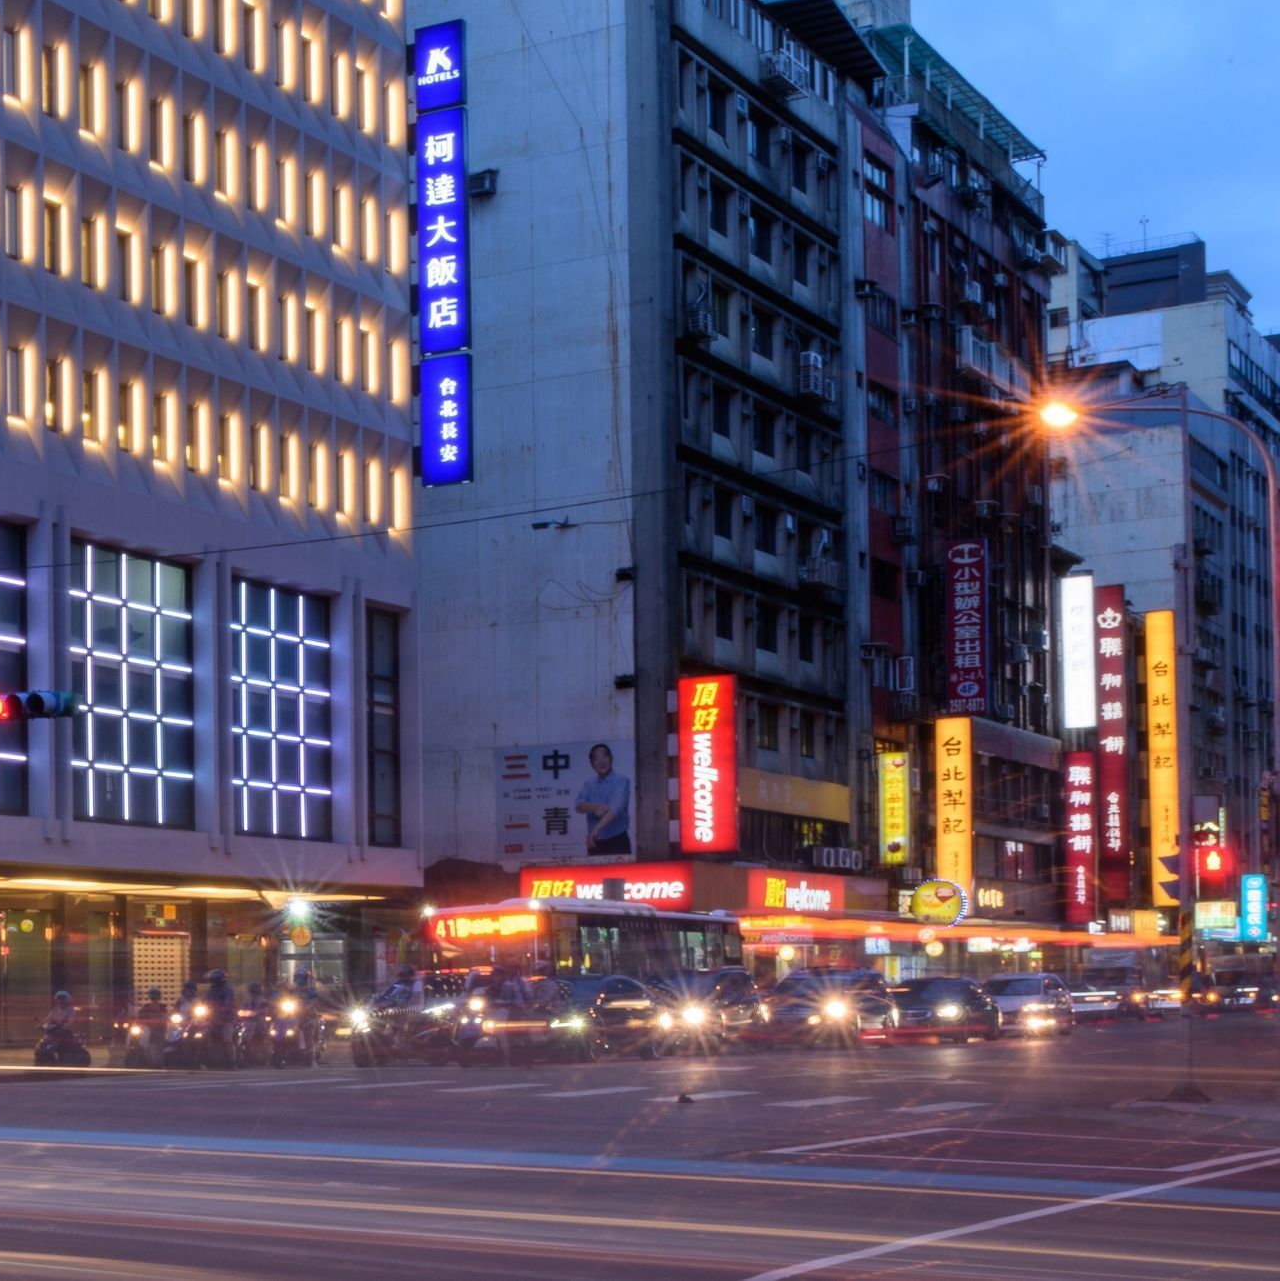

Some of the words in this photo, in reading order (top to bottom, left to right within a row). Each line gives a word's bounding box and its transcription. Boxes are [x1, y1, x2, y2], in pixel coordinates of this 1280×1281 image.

[418, 69, 460, 86] HOTELS
[424, 131, 459, 329] 柯達大飯店
[439, 376, 459, 463] 台北長安
[952, 567, 982, 669] 小型辦公室出租
[692, 682, 719, 732] 頂好
[960, 683, 976, 694] 4F
[693, 733, 719, 844] wellcome
[942, 736, 967, 835] 台北犁記
[531, 879, 575, 898] 頂好
[576, 880, 685, 900] wecome
[786, 881, 831, 912] wellcome
